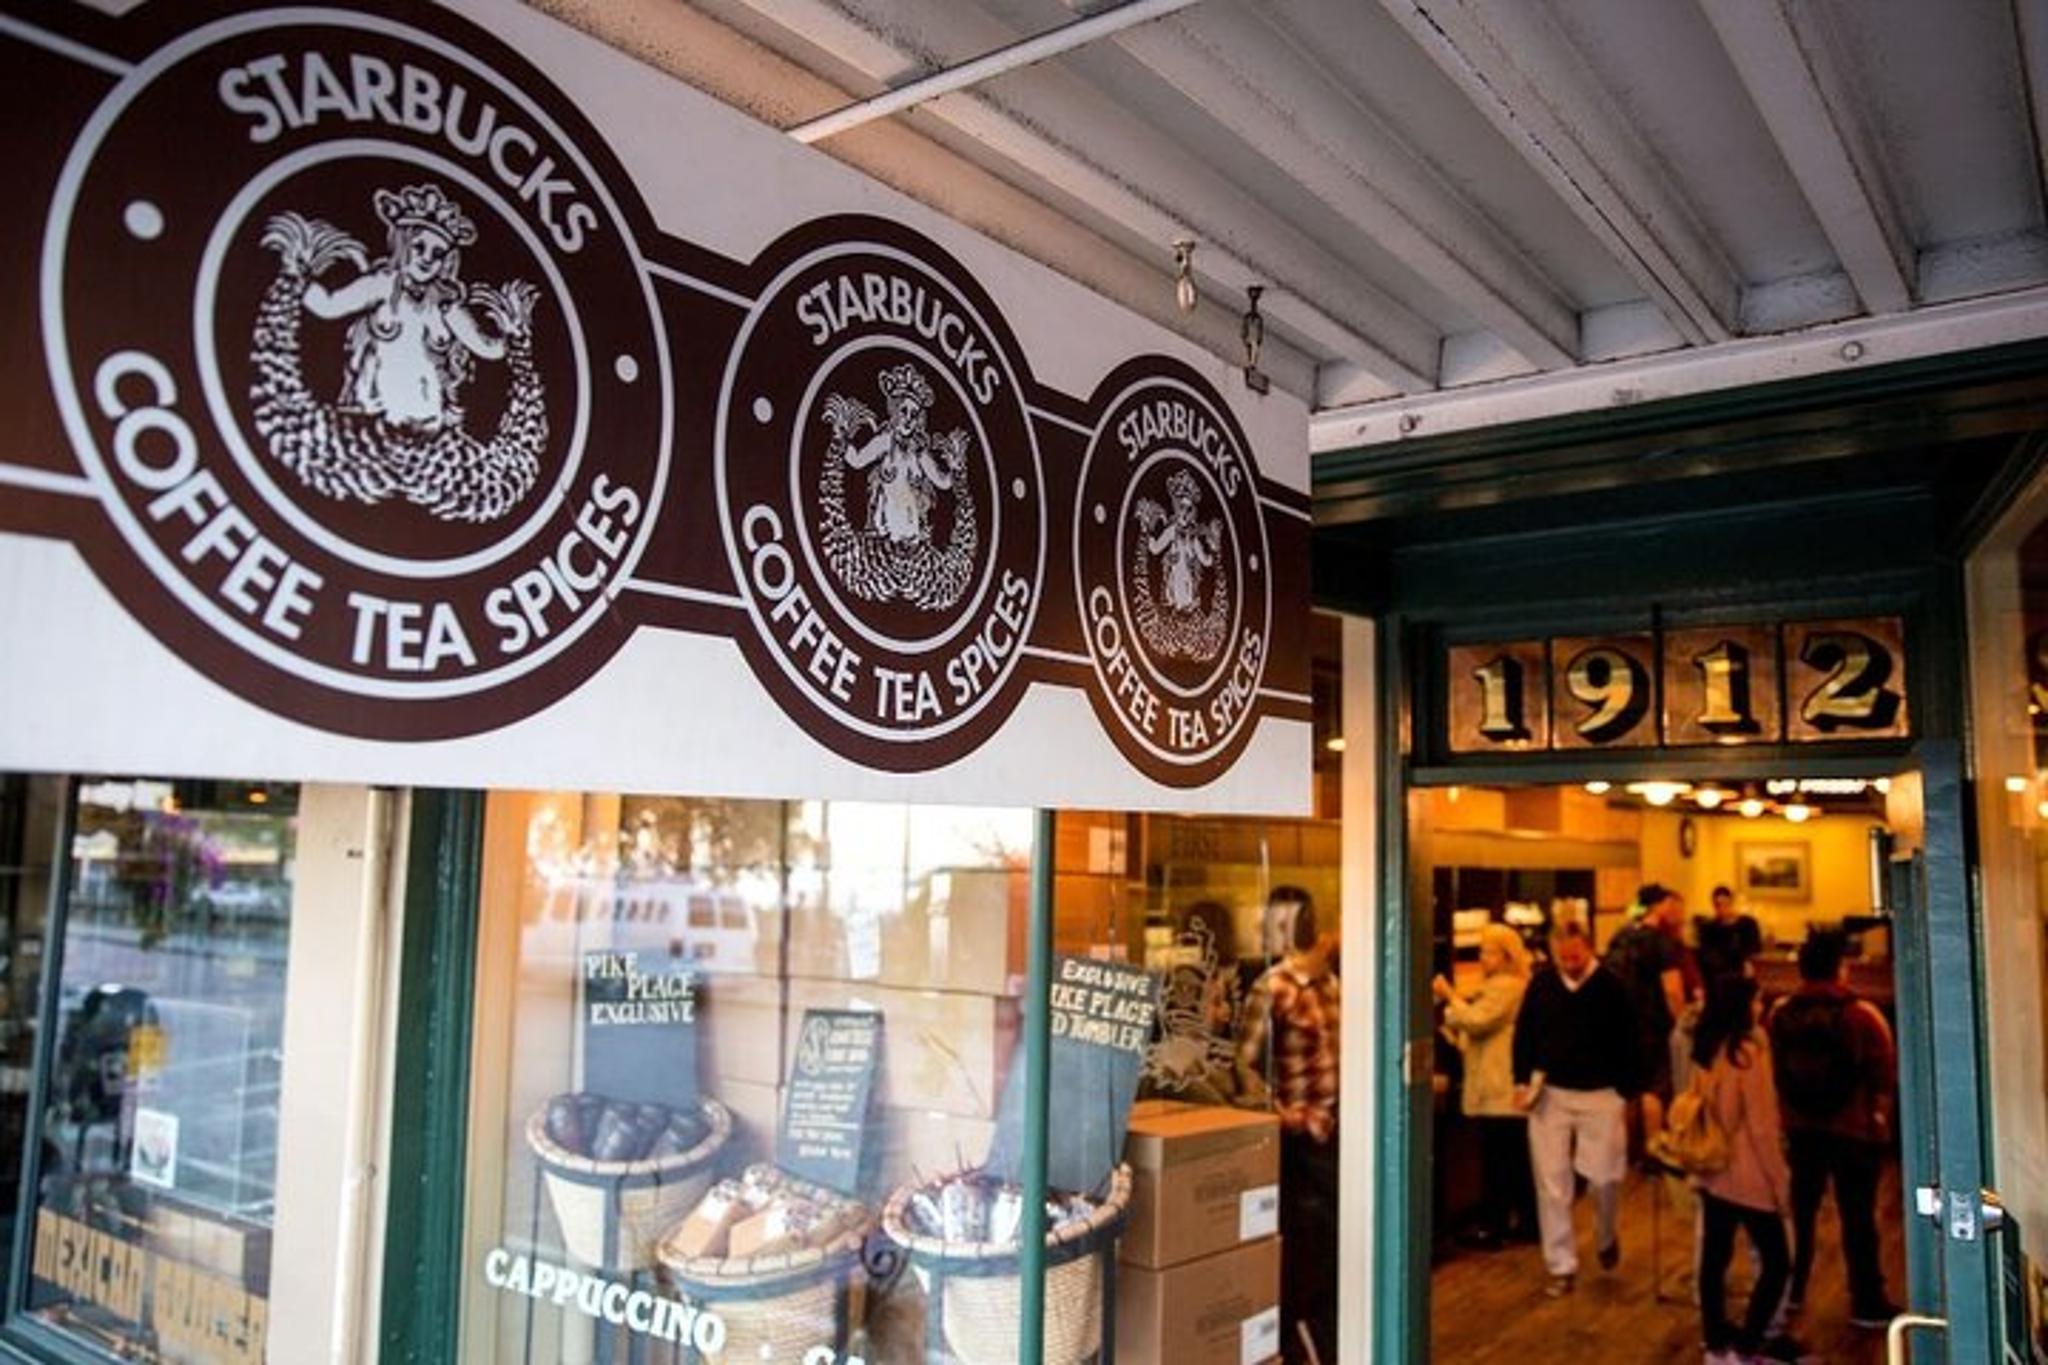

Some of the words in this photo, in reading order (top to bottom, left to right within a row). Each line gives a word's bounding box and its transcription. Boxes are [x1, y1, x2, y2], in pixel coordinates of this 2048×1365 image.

[218, 53, 598, 253] STARBUCKS
[796, 272, 1000, 405] STARBUCKS
[1118, 400, 1242, 498] STARBUCKS
[93, 349, 325, 640] COFFEE
[346, 592, 476, 671] TEA
[485, 473, 642, 653] SPICES
[741, 503, 863, 702] COFFEE
[873, 667, 943, 723] TEA
[945, 568, 1032, 707] SPICES
[1087, 584, 1159, 734] COFFEE
[1166, 708, 1210, 750] TEA
[1213, 626, 1264, 731] SPICES
[1472, 630, 1902, 743] 1912
[586, 952, 638, 979] PIKE
[591, 1001, 695, 1025] EXCLUSIVE
[627, 972, 695, 999] PLACE
[1050, 983, 1088, 1011] IKE
[1089, 991, 1154, 1025] PLACE
[484, 1247, 727, 1355] CAPPUCCINO
